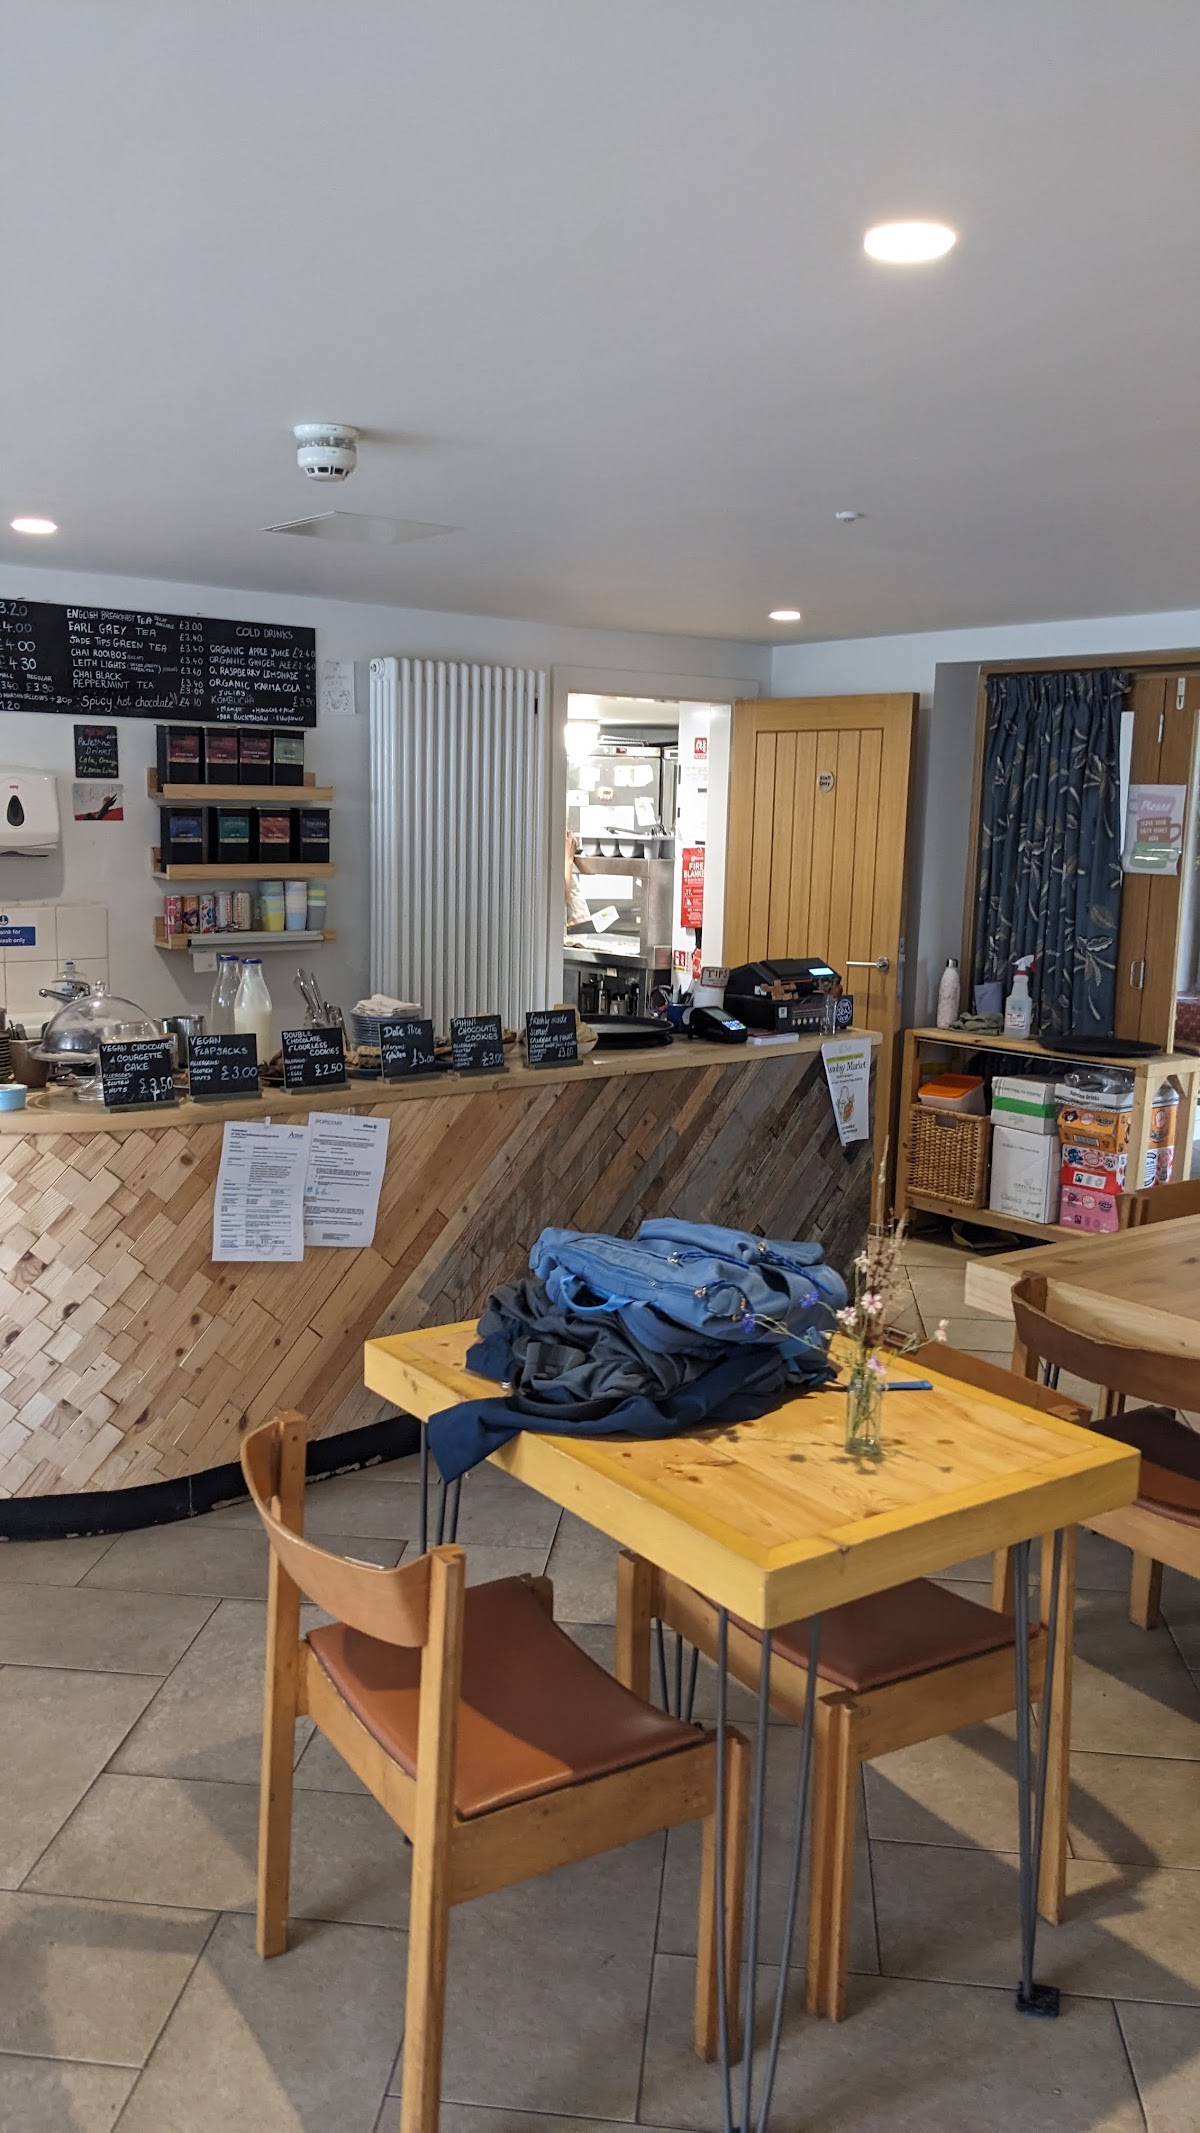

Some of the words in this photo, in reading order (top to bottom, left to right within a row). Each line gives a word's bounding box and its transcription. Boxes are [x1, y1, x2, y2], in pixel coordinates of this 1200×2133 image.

[66, 608, 98, 620] ENGLISH
[101, 610, 135, 622] BREAKFAST
[137, 615, 152, 625] TEA
[179, 620, 203, 631] £3.00
[0, 620, 32, 633] 4.00
[68, 621, 95, 633] EARL
[99, 623, 127, 636] GREY
[135, 627, 157, 637] TEA
[179, 633, 203, 642] £3.40
[235, 627, 260, 637] COLD
[263, 629, 294, 639] DRINKS
[69, 635, 91, 645] JADE
[94, 637, 111, 647] TIPS
[113, 639, 144, 649] GREEN
[148, 643, 167, 653] TEA
[180, 644, 204, 653] £3.40
[71, 648, 90, 657] CHAI
[180, 656, 204, 665] £3.40
[209, 644, 244, 655] ORGANIC
[248, 647, 268, 656] APPLE
[270, 648, 290, 658] JUICE
[72, 659, 98, 668] LEITH
[100, 661, 126, 670] LIGHTS
[209, 655, 246, 666] ORGANIC
[248, 658, 276, 668] GINGER
[279, 661, 291, 670] ALE
[73, 669, 92, 679] CHAI
[95, 671, 122, 681] BLACK
[220, 666, 260, 678] RASPBERRY
[263, 670, 299, 680] LEMONADE
[73, 679, 130, 689] PEPPERMINT
[136, 681, 155, 689] TEA
[209, 679, 250, 690] ORGANIC
[254, 682, 281, 693] KARMA
[282, 683, 301, 693] COLA
[80, 695, 112, 712] Spicy
[117, 696, 132, 706] hot
[135, 695, 174, 708] chocolate
[211, 695, 255, 706] KOMBUCHA
[689, 862, 704, 871] FIRE
[683, 869, 705, 878] BLANKE
[706, 969, 728, 979] TIPS
[451, 1018, 477, 1027] TAHINI
[283, 1030, 313, 1040] DOUBLE
[383, 1025, 405, 1038] Date
[457, 1023, 498, 1036] CHOCOLATE
[190, 1035, 221, 1046] VEGAN
[286, 1035, 322, 1045] CHOCOLATE
[464, 1032, 498, 1043] COOKIES
[101, 1044, 127, 1053] VEGAN
[131, 1042, 170, 1052] CHOCOLATE
[194, 1046, 248, 1056] FLAPJACKS
[288, 1041, 328, 1053] FLOURLESS
[309, 1046, 340, 1056] COOKIES
[117, 1052, 163, 1063] COURGETTE
[124, 1062, 150, 1071] CAKE
[314, 1062, 343, 1077] £2.50
[221, 1065, 258, 1081] £3.00
